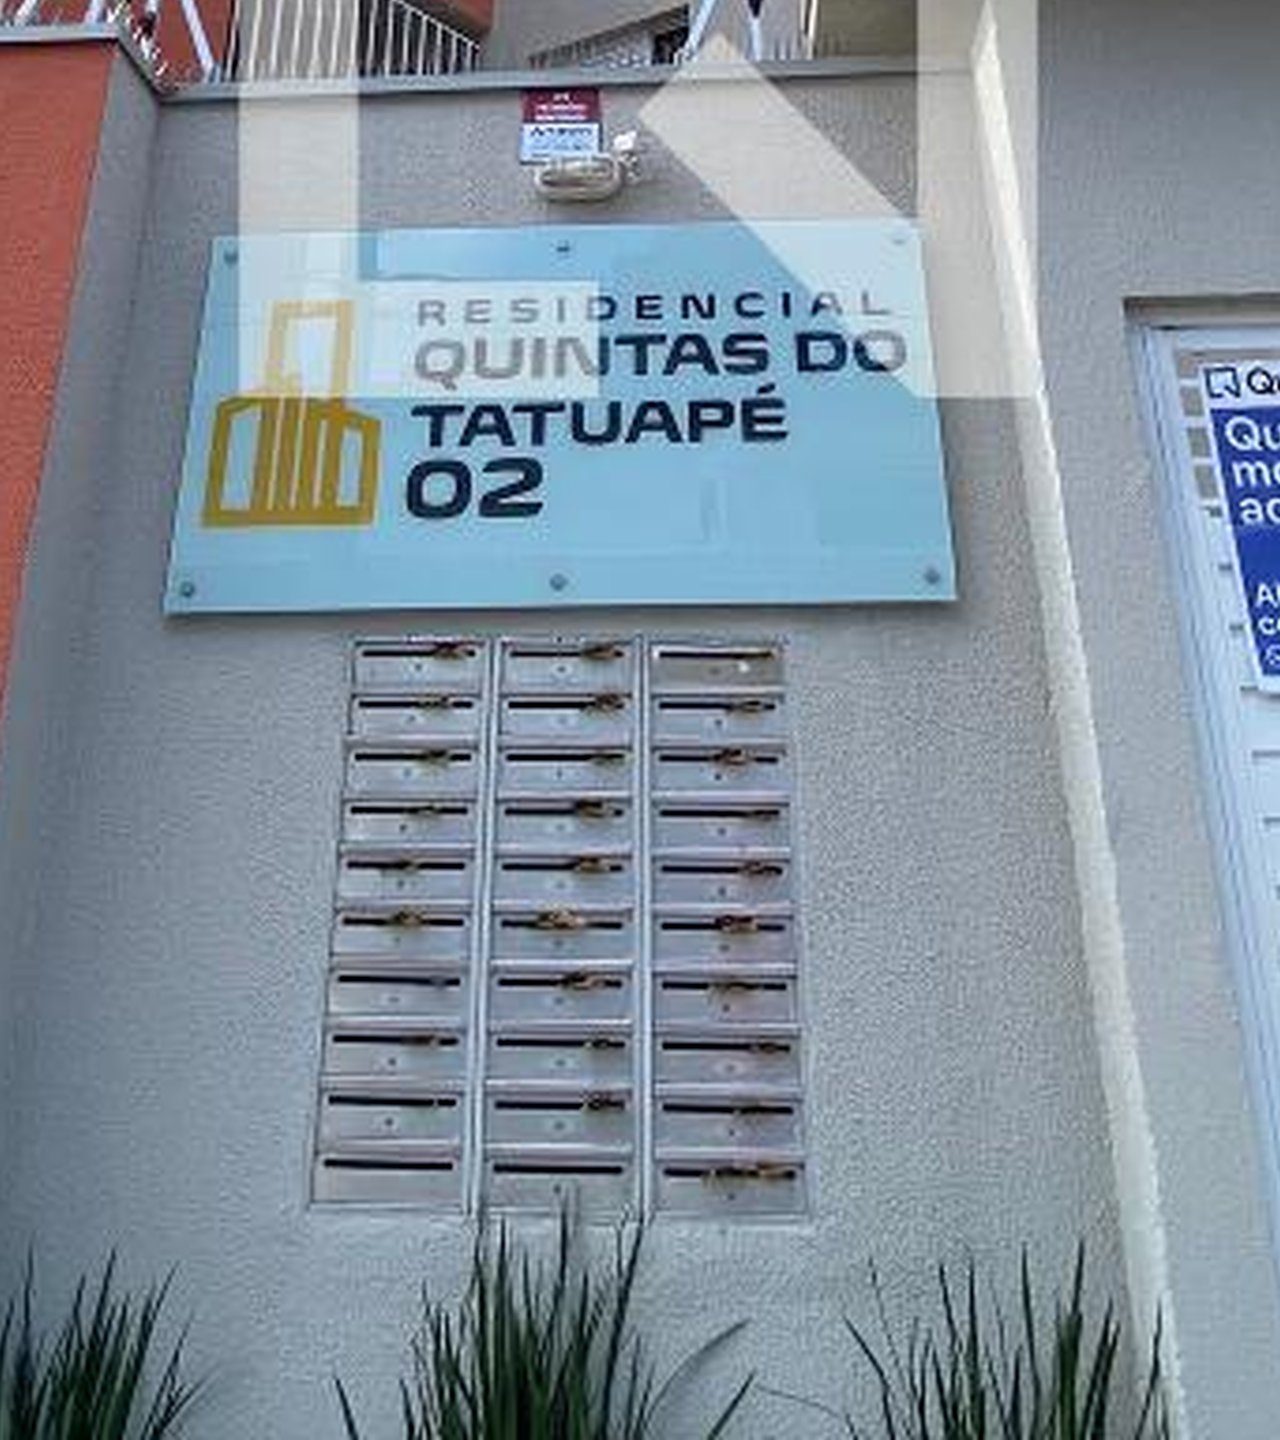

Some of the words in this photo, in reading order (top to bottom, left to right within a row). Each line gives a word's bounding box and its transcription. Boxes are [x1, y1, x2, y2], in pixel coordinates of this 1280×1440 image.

[417, 290, 892, 327] RESIDENCIAL
[414, 332, 770, 391] QUINTAS
[795, 329, 907, 373] DO
[411, 383, 789, 448] TATUAPÉ
[405, 457, 545, 520] 02
